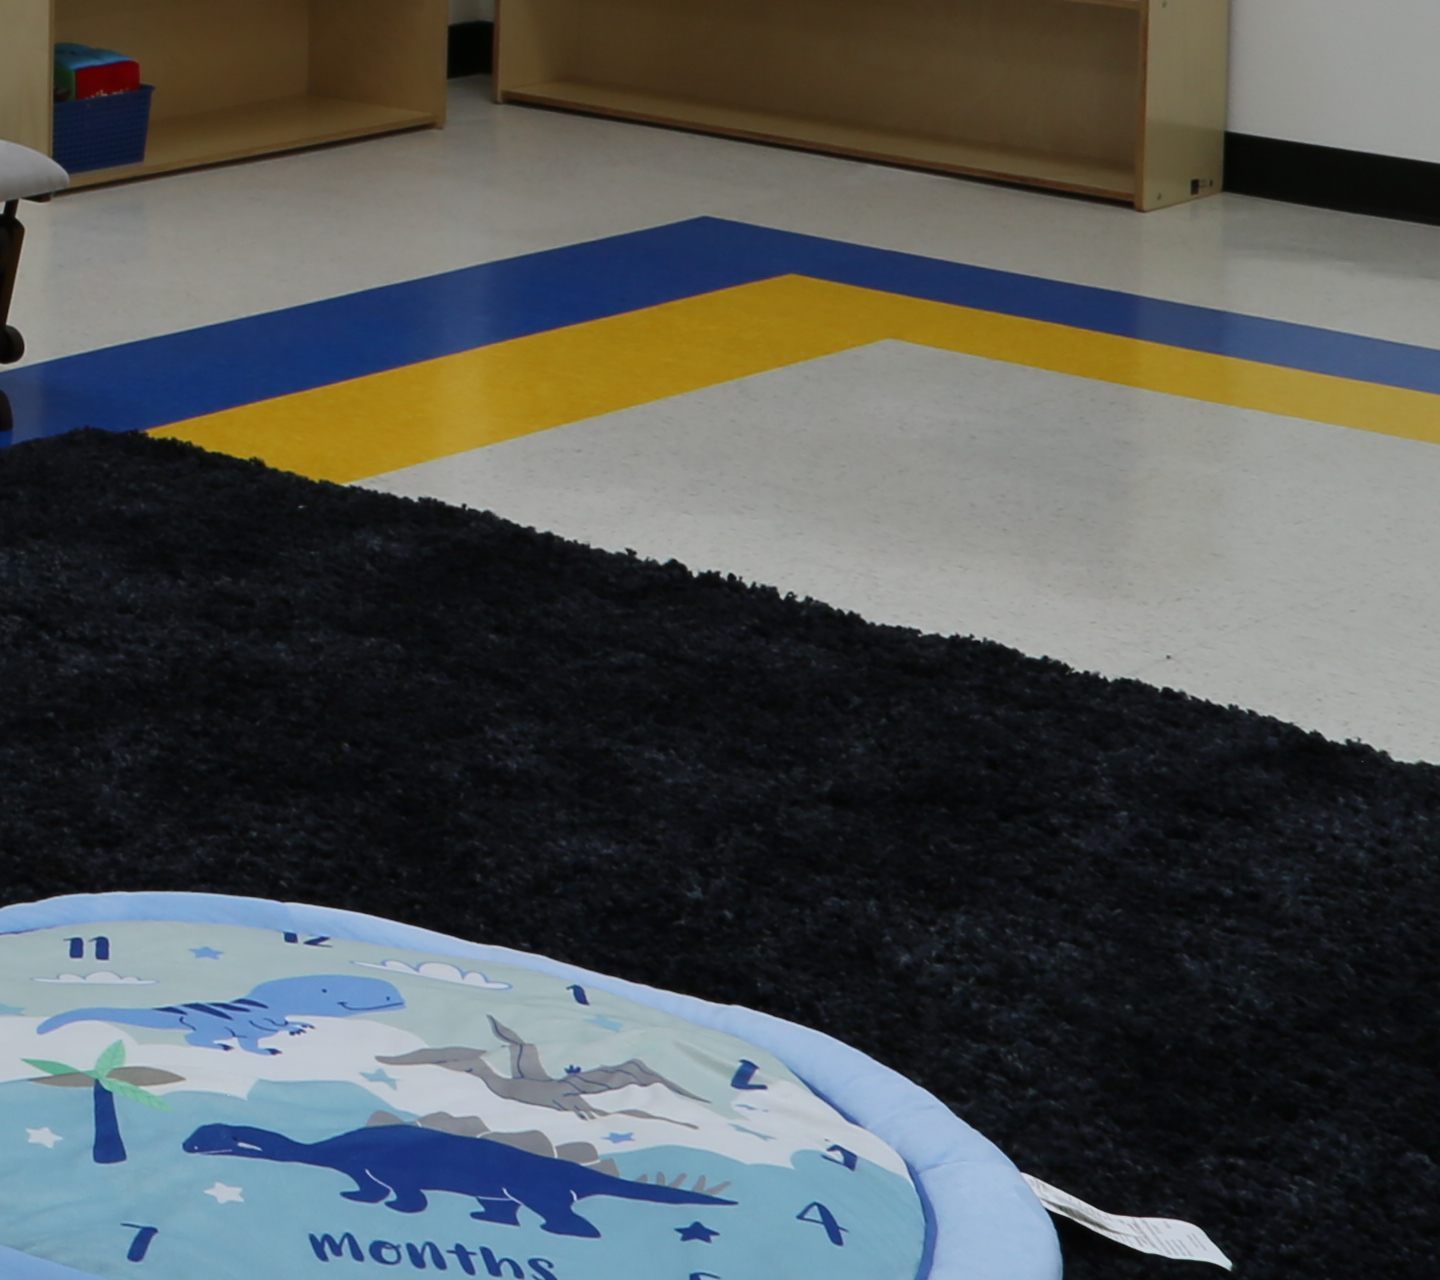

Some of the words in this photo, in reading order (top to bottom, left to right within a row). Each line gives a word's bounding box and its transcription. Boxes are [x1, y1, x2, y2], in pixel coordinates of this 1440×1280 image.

[65, 936, 110, 960] 11
[120, 1222, 159, 1263] 7
[796, 1201, 850, 1247] 4
[308, 1232, 558, 1280] months
